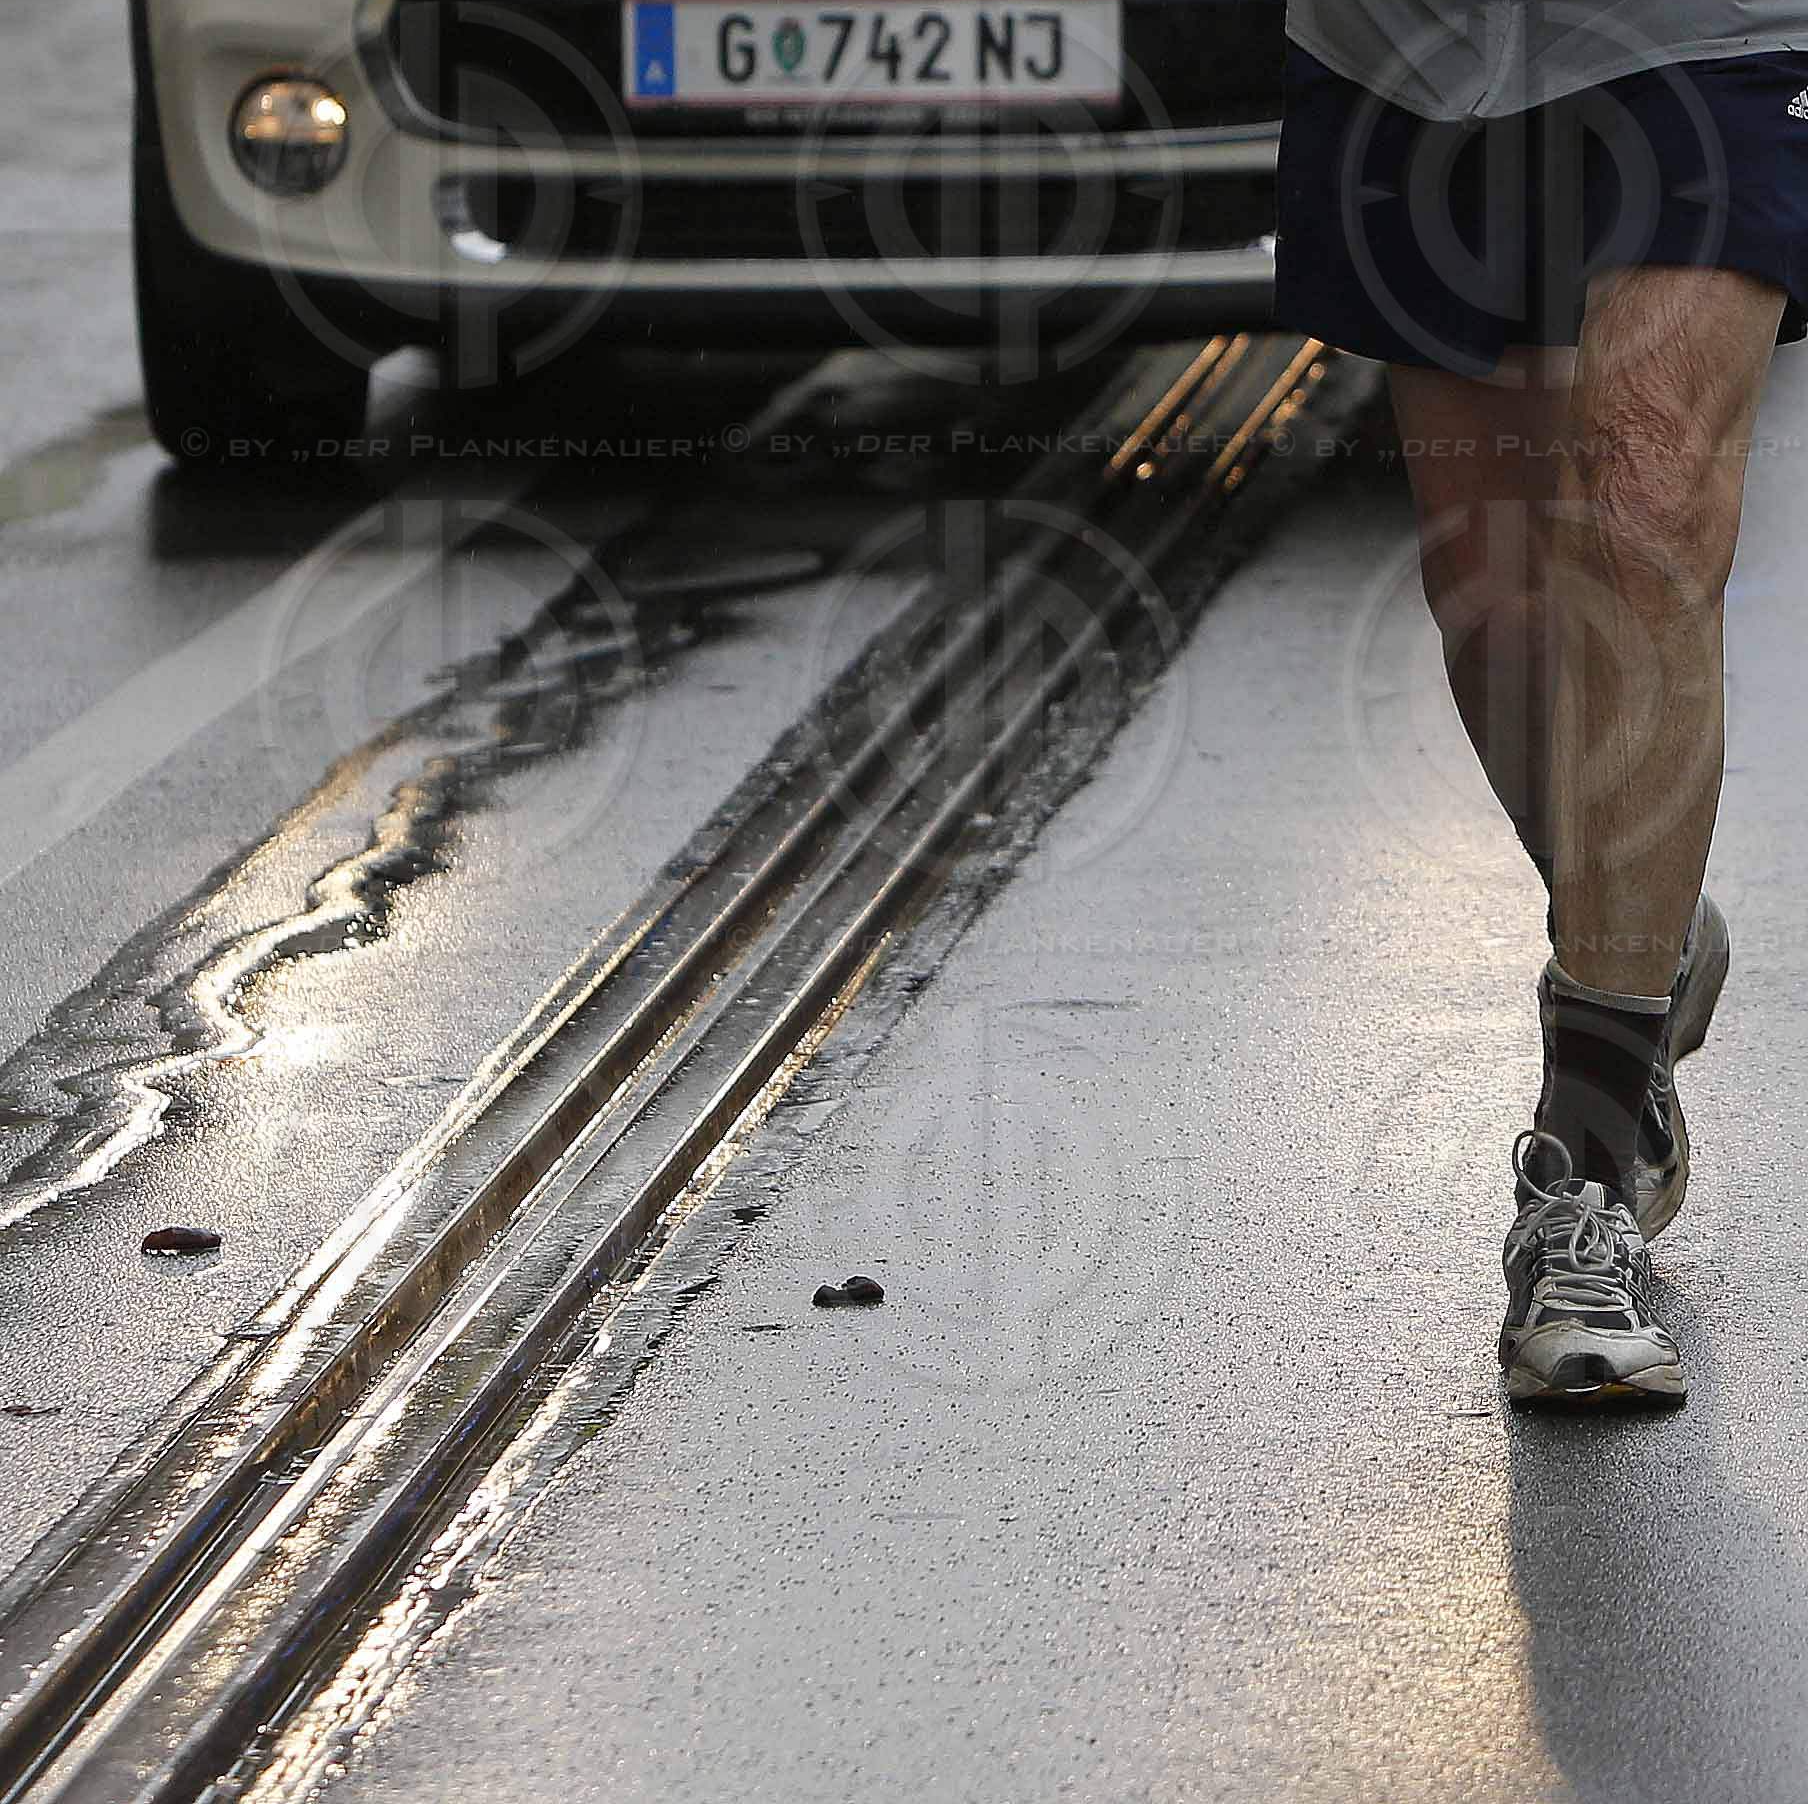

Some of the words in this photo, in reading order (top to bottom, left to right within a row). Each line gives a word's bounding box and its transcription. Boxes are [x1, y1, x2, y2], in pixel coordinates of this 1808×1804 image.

[717, 13, 756, 84] G
[816, 13, 953, 83] 742
[976, 12, 1065, 82] NJ
